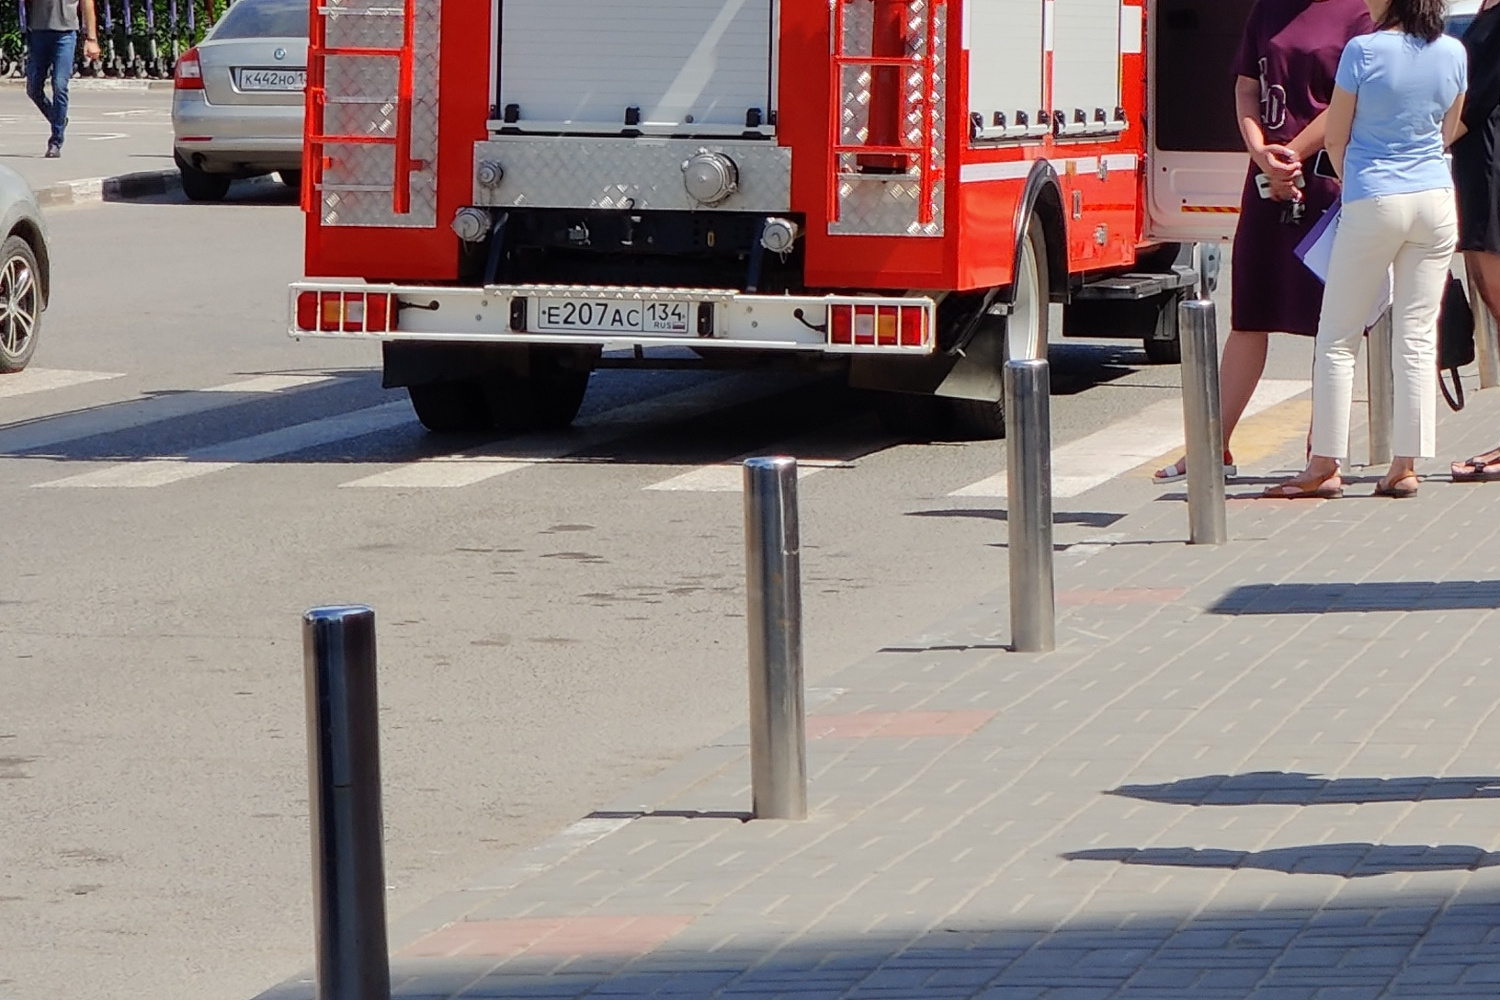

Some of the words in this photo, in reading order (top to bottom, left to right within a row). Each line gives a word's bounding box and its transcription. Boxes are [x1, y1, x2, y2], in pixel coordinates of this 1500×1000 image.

[547, 301, 640, 327] Е207АС
[647, 303, 682, 321] 134
[653, 322, 672, 330] RUS
